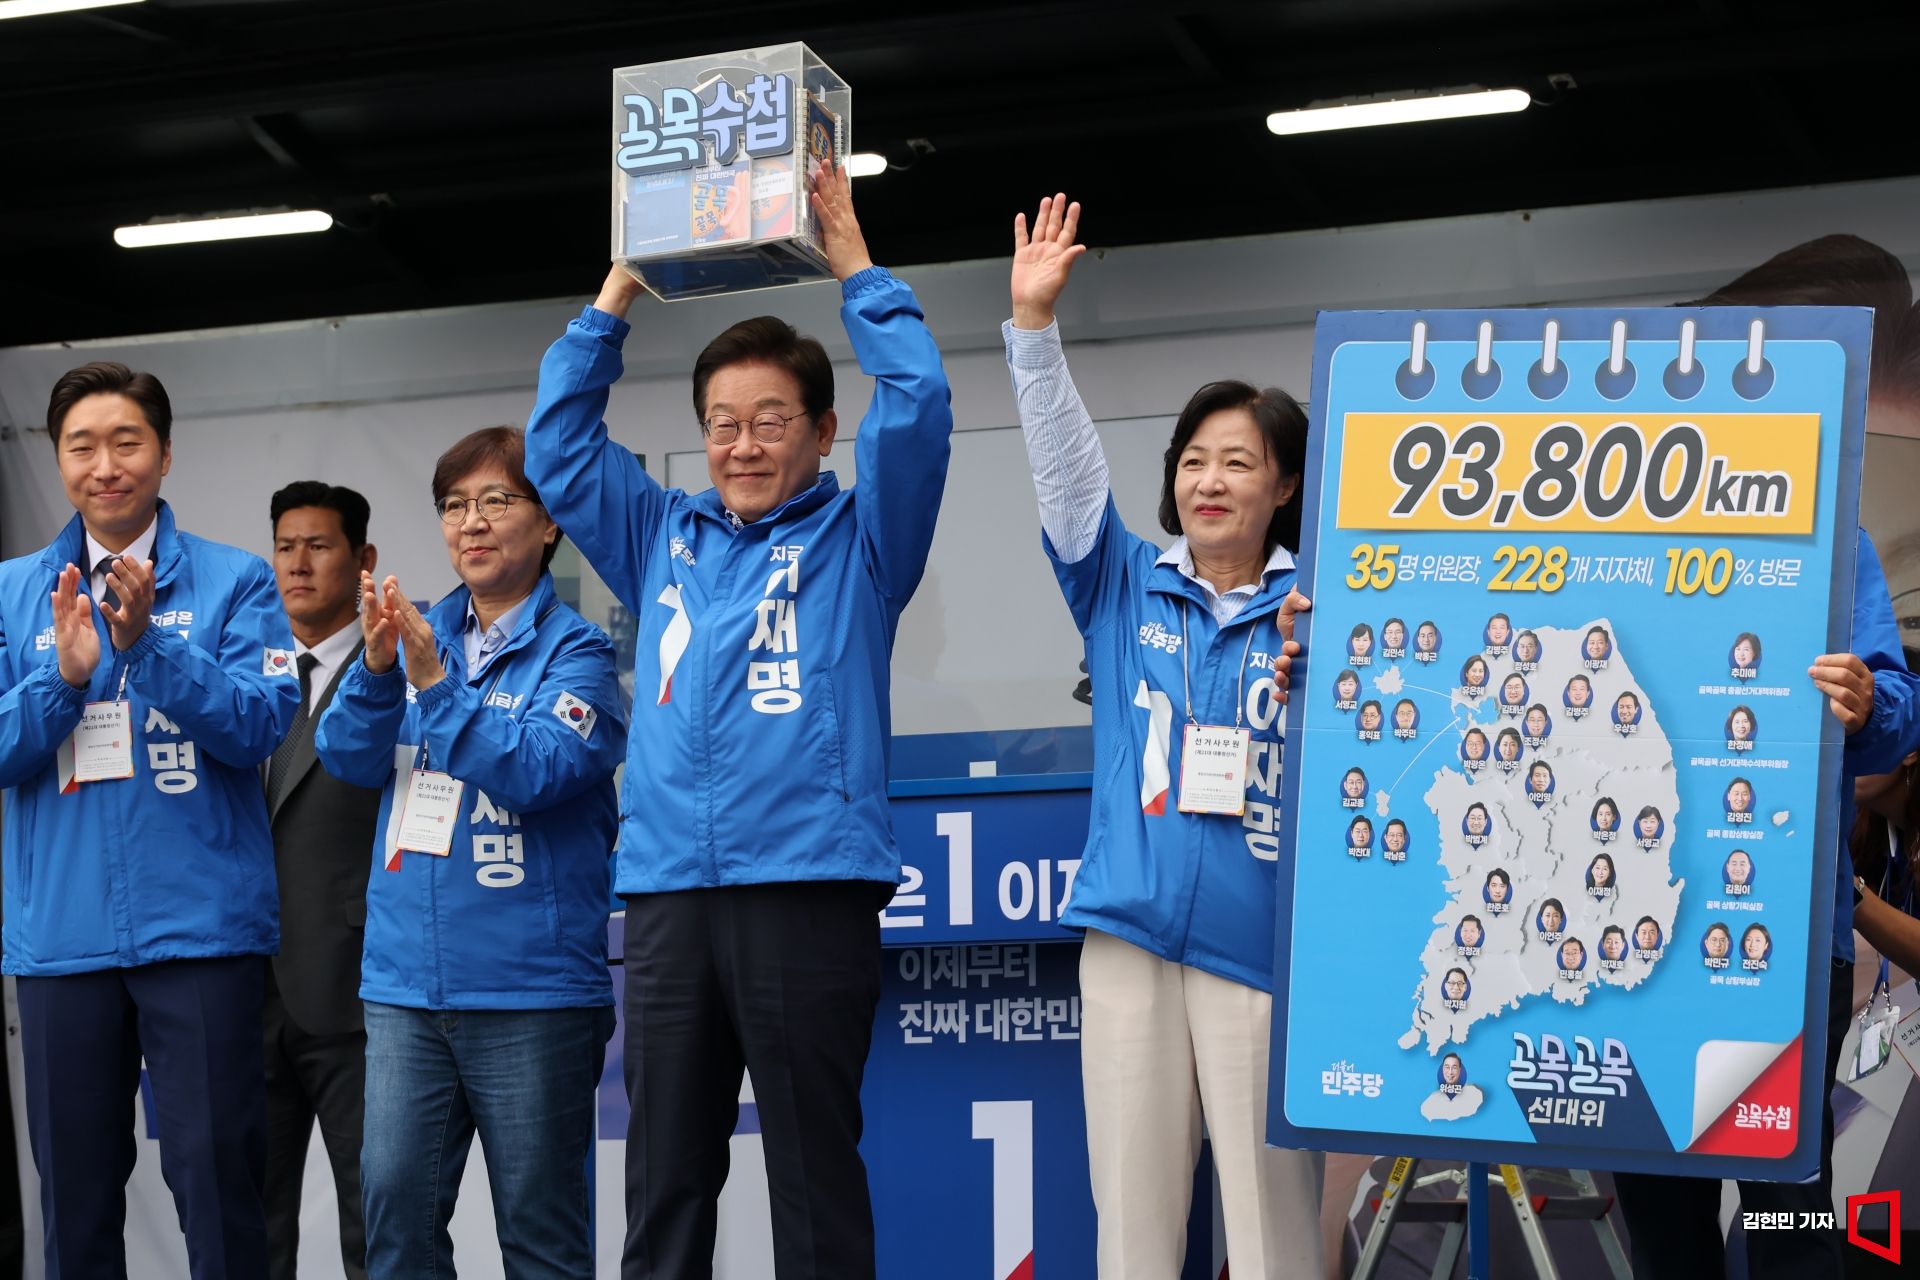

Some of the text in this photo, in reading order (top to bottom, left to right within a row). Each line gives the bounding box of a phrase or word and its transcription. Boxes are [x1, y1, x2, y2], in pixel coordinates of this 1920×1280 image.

[617, 74, 790, 170] 골목수첩
[1345, 543, 1802, 595] 35명 위원장, 228개 지자체, 100% 방문
[747, 560, 803, 714] 이재명
[1139, 625, 1183, 654] 민주당
[1383, 648, 1405, 658] 김민석
[1486, 645, 1509, 655] 김병주
[1349, 656, 1371, 665] 전현희
[1414, 652, 1437, 662] 박홍근
[1514, 661, 1537, 671] 정성호
[1584, 659, 1607, 669] 이광재
[1731, 668, 1756, 678] 추미애
[1461, 686, 1485, 696] 유은혜
[1698, 686, 1726, 695] 골목골목
[1335, 700, 1357, 709] 서영교
[1501, 704, 1525, 715] 김태년
[1565, 706, 1589, 717] 김병주
[81, 712, 121, 723] 선거사무원
[1394, 728, 1417, 738] 박주민
[1614, 724, 1637, 734] 우상호
[1195, 738, 1240, 749] 선거사무원
[1523, 737, 1548, 746] 조정식
[1727, 740, 1753, 750] 한정애
[1133, 679, 1173, 817] 1
[1496, 760, 1519, 770] 이언주
[1690, 757, 1718, 767] 골목골목
[417, 782, 455, 794] 선거사무원
[1528, 792, 1551, 802] 이인영
[1727, 812, 1752, 823] 김영진
[1465, 834, 1488, 844] 박범계
[1593, 830, 1617, 841] 박은정
[1706, 829, 1721, 838] 골목
[1636, 838, 1660, 848] 서영교
[1348, 847, 1371, 857] 박찬대
[936, 811, 973, 926] 1
[1588, 886, 1611, 897] 이재정
[1725, 884, 1750, 895] 김원이
[1486, 903, 1509, 913] 한준호
[1706, 900, 1721, 910] 골목
[1539, 931, 1562, 942] 이언주
[1457, 946, 1480, 956] 정청래
[1635, 949, 1658, 960] 김영춘
[899, 946, 1037, 990] 이제부터
[1600, 958, 1624, 969] 박재호
[1704, 957, 1729, 969] 박민규
[1742, 959, 1768, 970] 전진숙
[1709, 975, 1724, 985] 골목
[1444, 999, 1467, 1010] 박지원
[899, 996, 1082, 1044] 진짜 대한민
[1331, 1060, 1354, 1073] 더불어
[1507, 1031, 1633, 1097] 골목골목
[1322, 1071, 1384, 1098] 민주당
[1439, 1083, 1462, 1094] 위성곤
[1527, 1097, 1606, 1127] 선대위
[1734, 1102, 1791, 1130] 골목수첩
